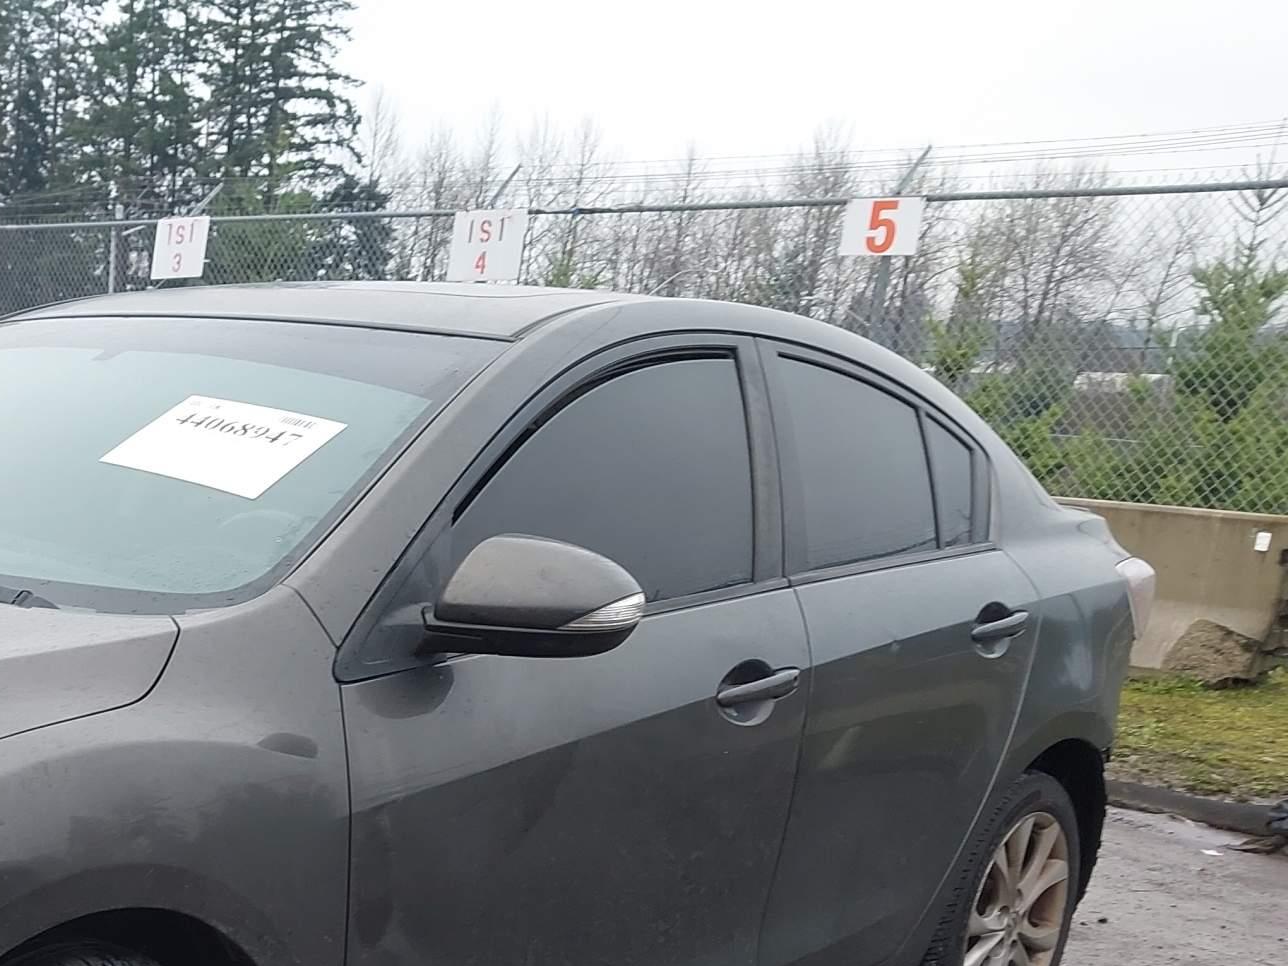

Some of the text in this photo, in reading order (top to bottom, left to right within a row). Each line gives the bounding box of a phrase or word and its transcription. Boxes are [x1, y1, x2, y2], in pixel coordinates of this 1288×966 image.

[865, 199, 900, 254] 5
[172, 254, 182, 273] 3
[474, 250, 487, 275] 4
[175, 412, 304, 447] 44068947
